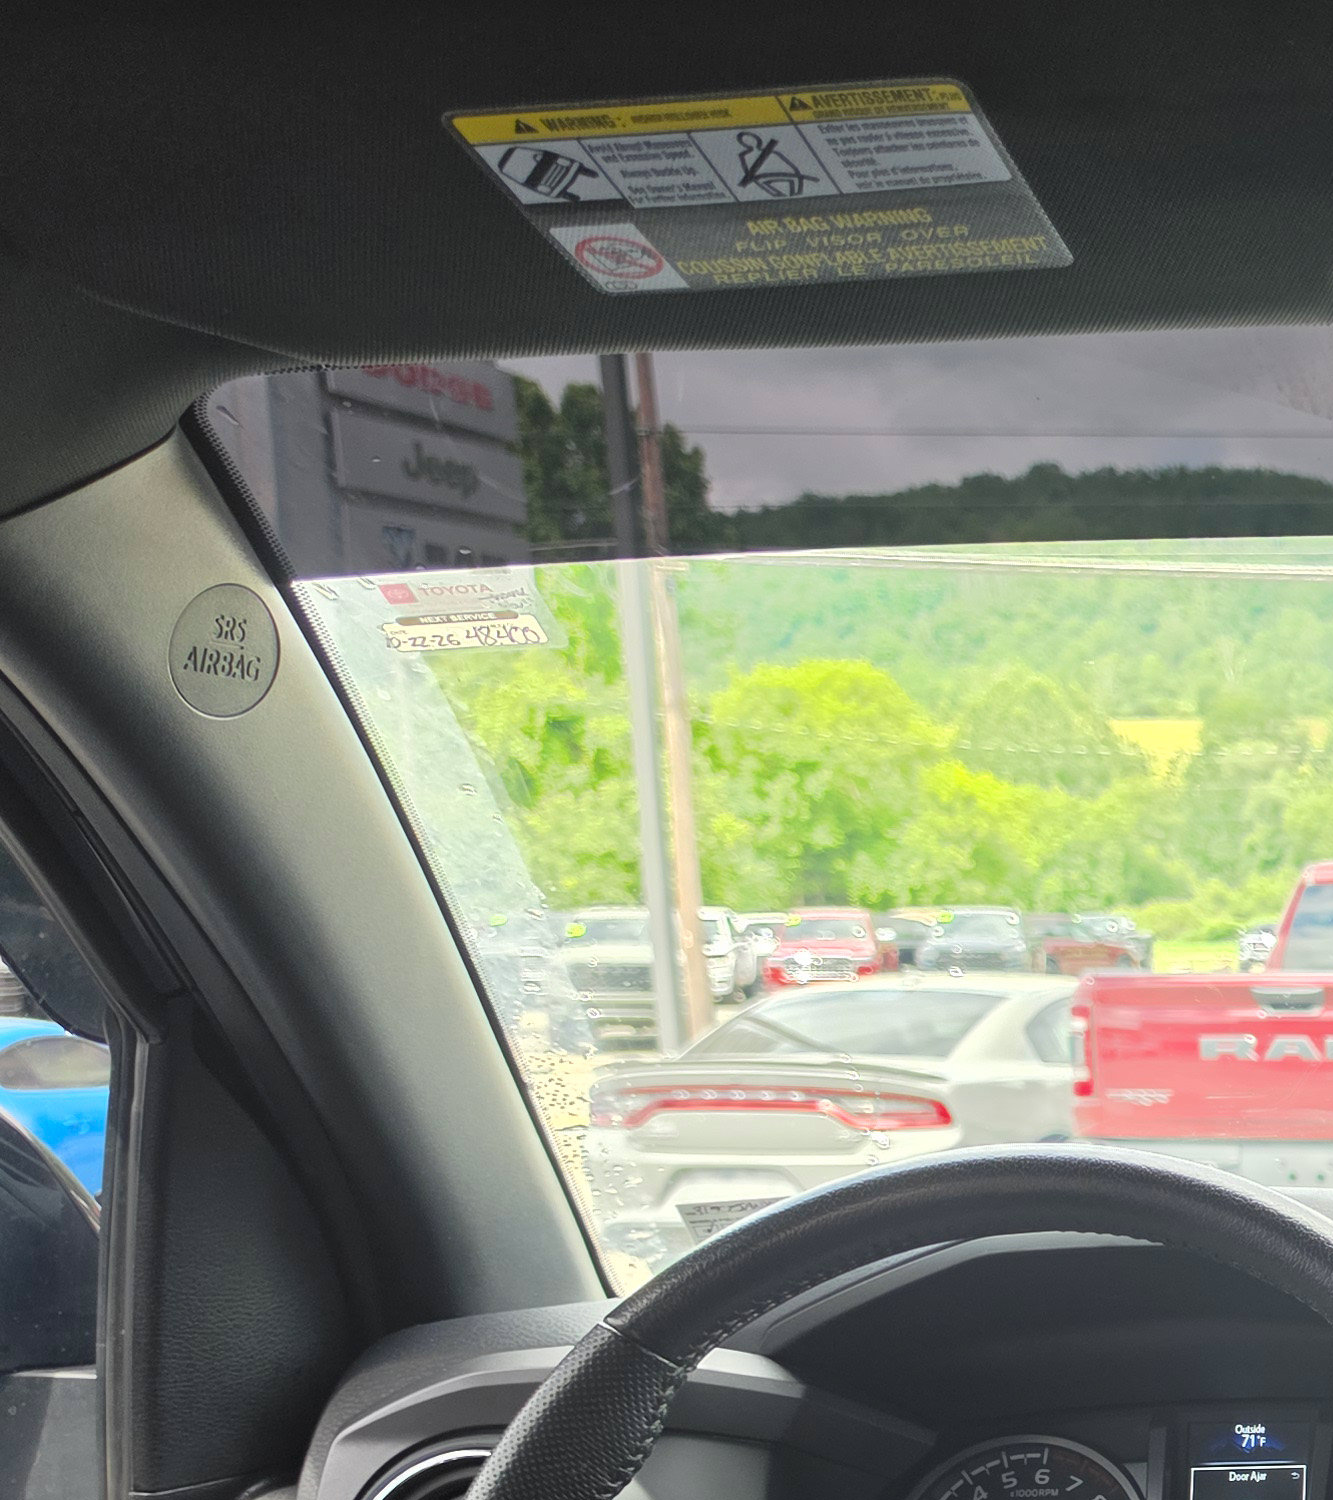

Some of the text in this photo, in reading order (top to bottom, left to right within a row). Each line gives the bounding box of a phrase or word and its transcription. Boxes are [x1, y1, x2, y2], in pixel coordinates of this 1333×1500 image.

[747, 207, 933, 236] AIR BAG WARNING
[735, 225, 970, 253] FLIP VISOR OVER
[419, 583, 493, 596] TOYOTA
[420, 612, 497, 624] NEXT SERVICE
[214, 614, 247, 642] SRS
[182, 646, 261, 681] AIRBAG
[1234, 1423, 1266, 1434] Outside
[1001, 1471, 1018, 1489] 5
[1034, 1468, 1050, 1485] 6
[1065, 1475, 1084, 1492] 7
[1229, 1470, 1267, 1482] Door Ajar
